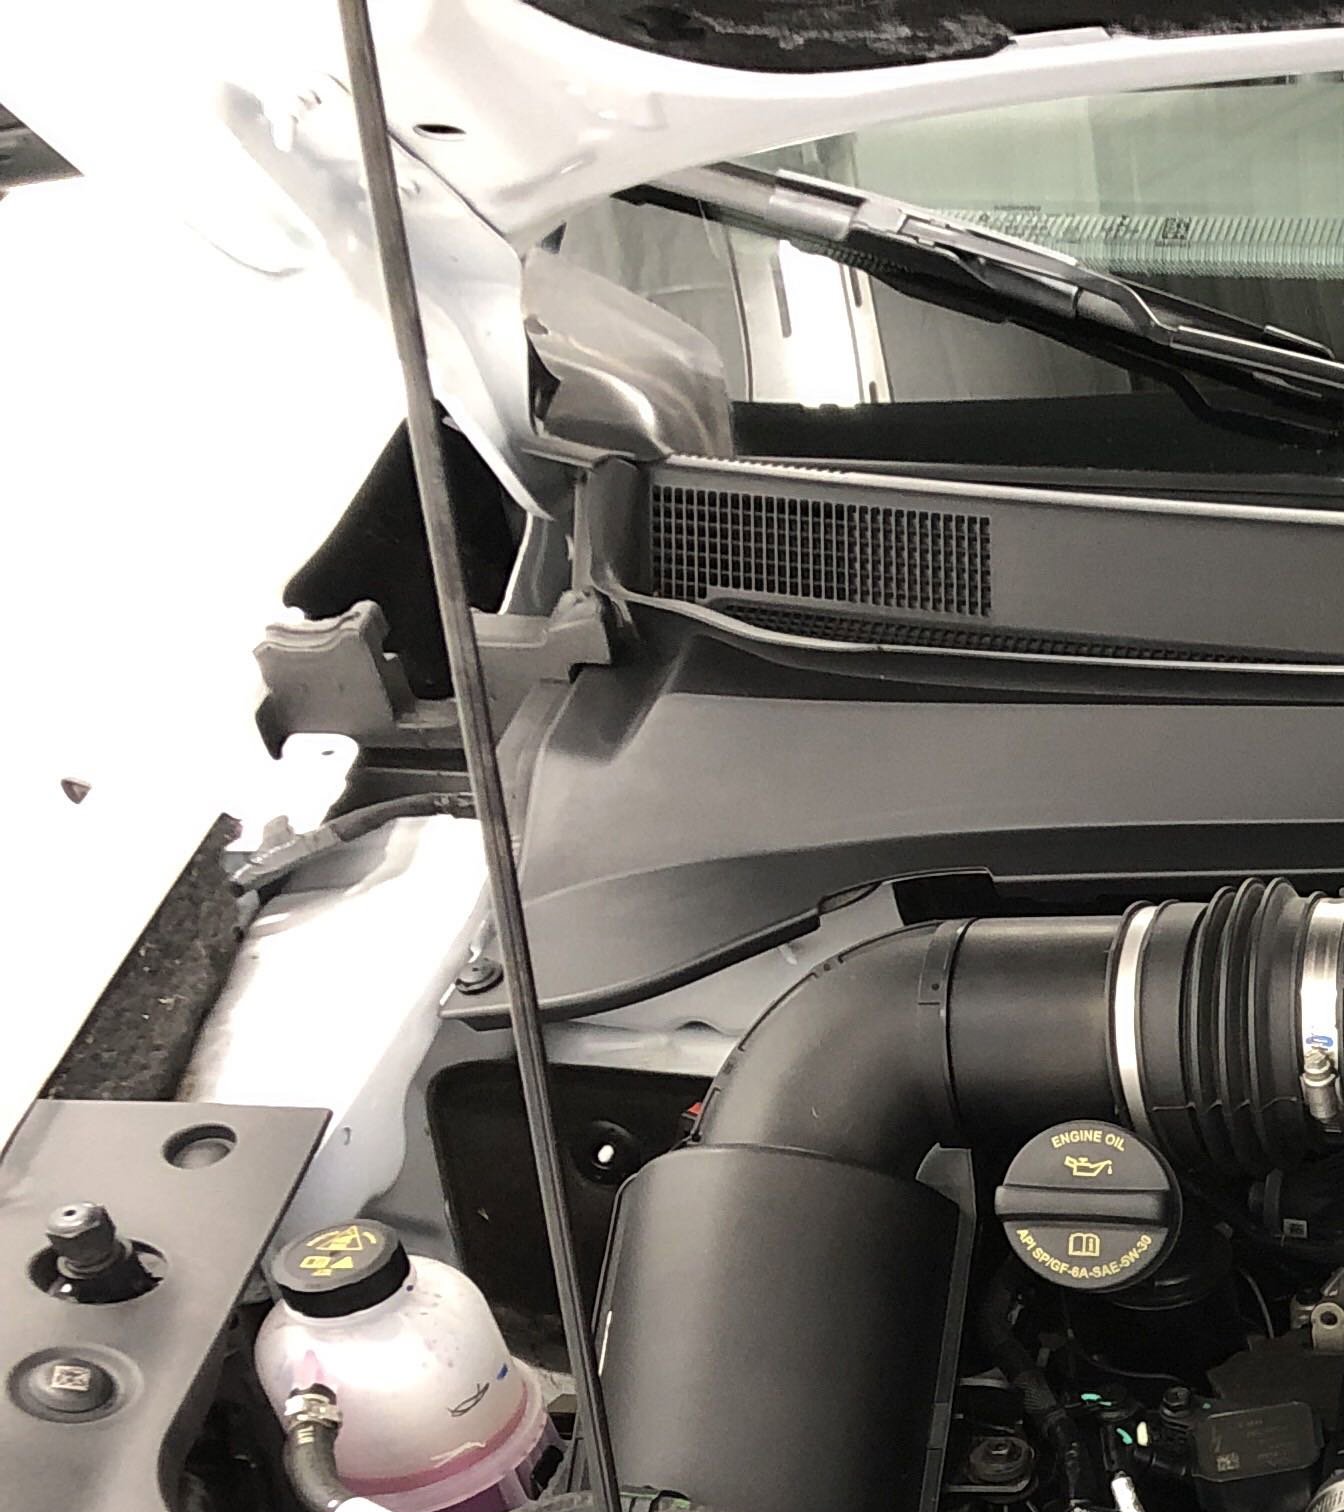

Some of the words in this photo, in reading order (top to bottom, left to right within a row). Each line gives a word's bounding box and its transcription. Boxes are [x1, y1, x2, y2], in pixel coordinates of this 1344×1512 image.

[1050, 1129, 1103, 1149] ENGINE
[1104, 1132, 1126, 1152] OIL
[1015, 1228, 1036, 1251] API
[1031, 1234, 1152, 1279] SP/GF-6A-SAE-5W-30
